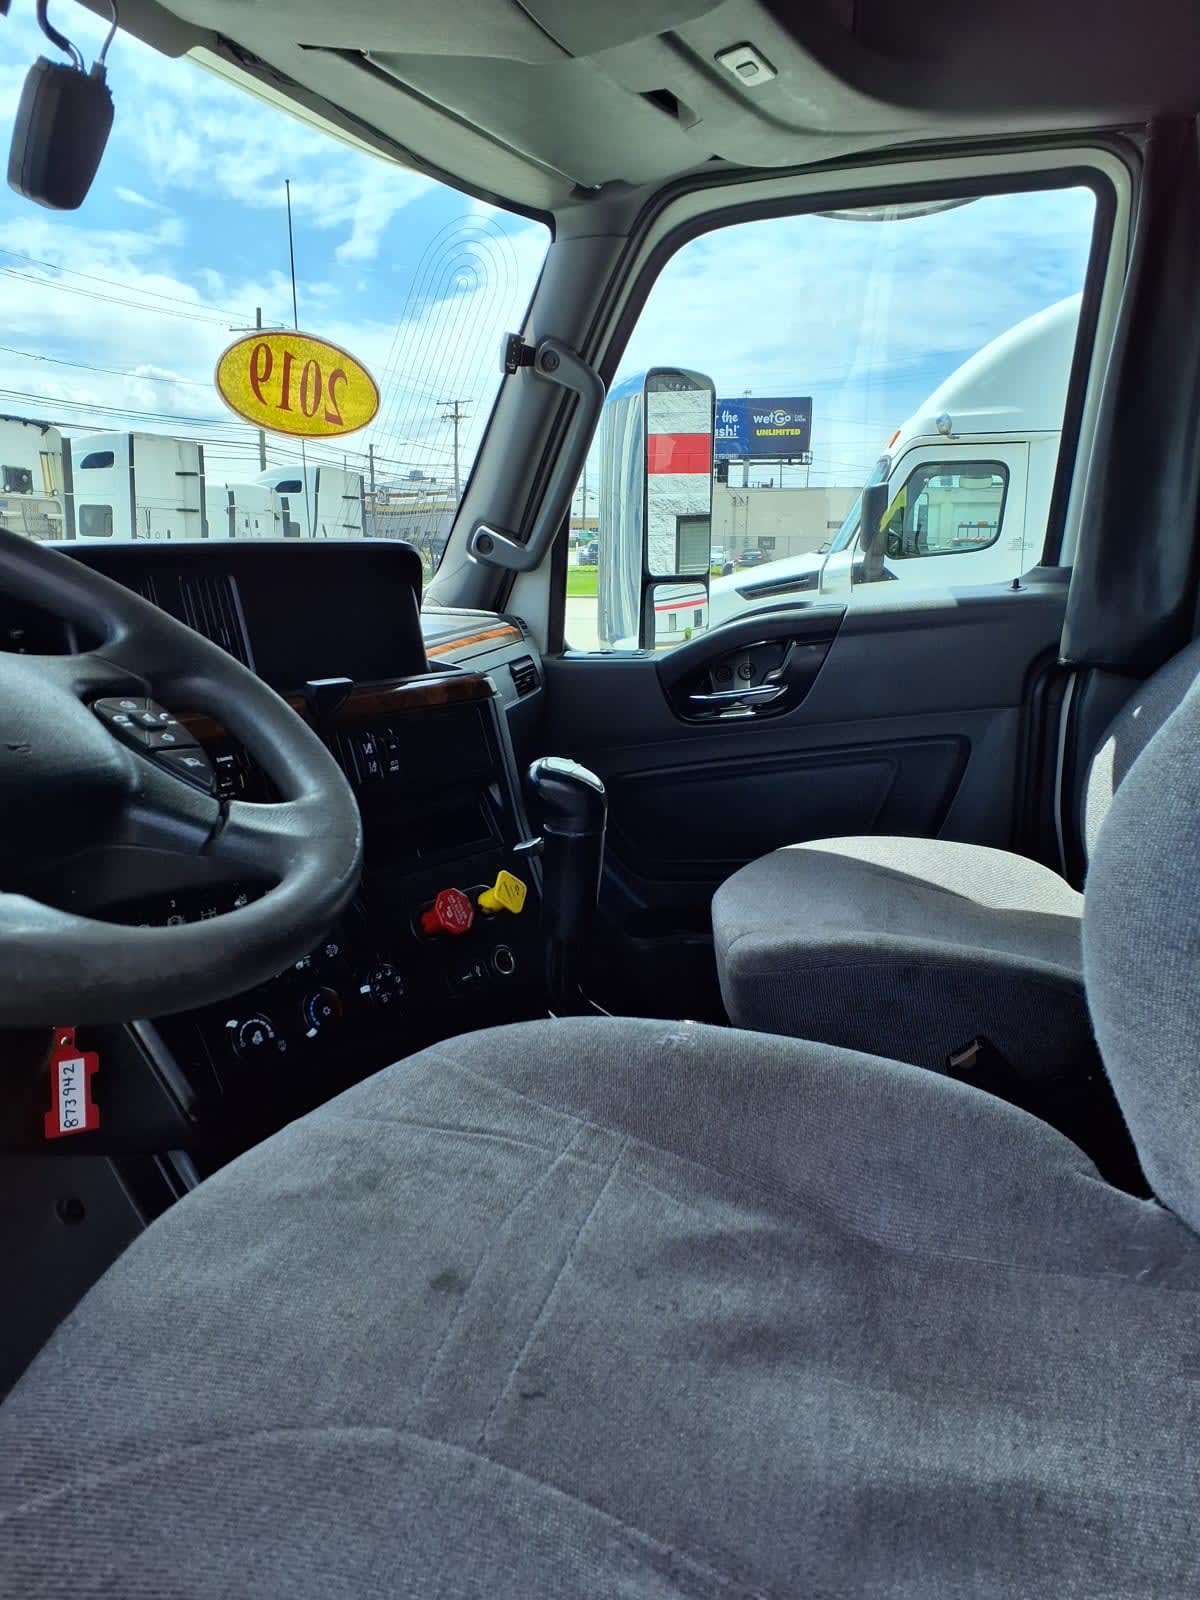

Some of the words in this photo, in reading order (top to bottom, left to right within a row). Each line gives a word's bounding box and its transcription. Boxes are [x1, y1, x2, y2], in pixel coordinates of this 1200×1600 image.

[722, 410, 738, 423] the
[753, 411, 791, 425] wetGo
[756, 428, 801, 437] UNLIMITED
[62, 1063, 79, 1129] 873942
